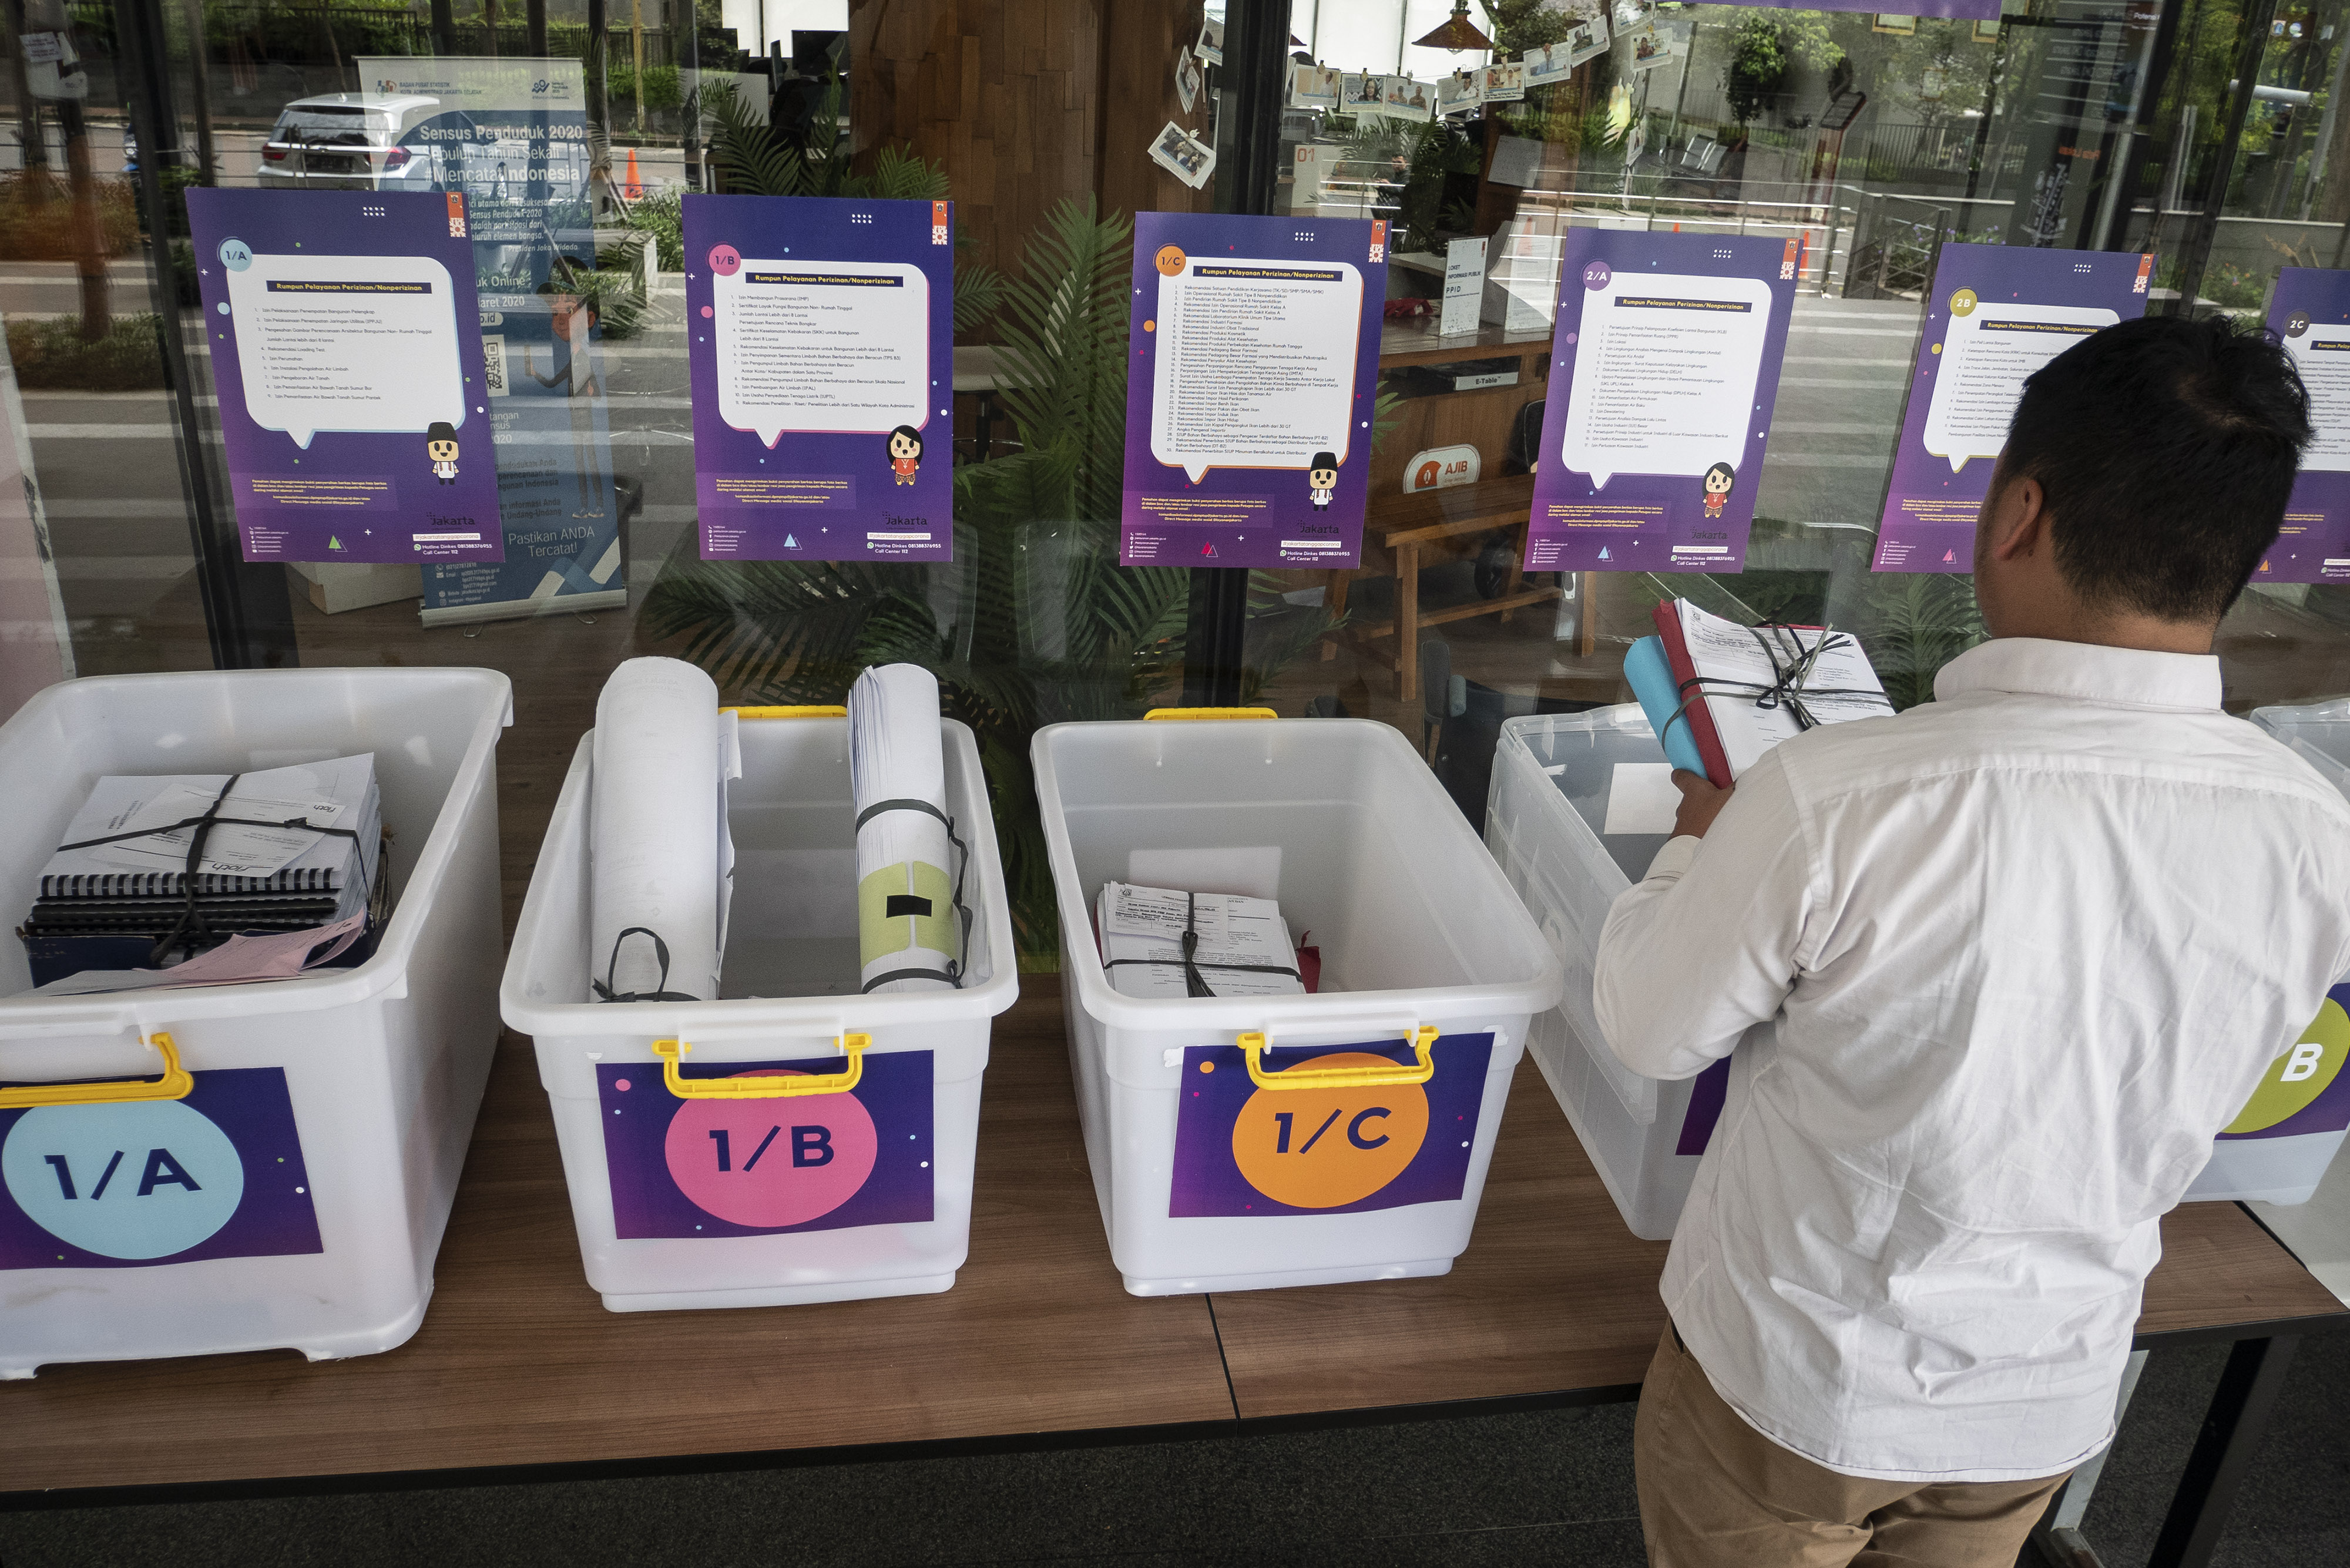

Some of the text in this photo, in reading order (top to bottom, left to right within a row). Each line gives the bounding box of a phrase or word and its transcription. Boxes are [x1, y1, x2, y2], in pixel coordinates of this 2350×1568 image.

[420, 125, 582, 140] Sensus Penduduk 2020
[422, 146, 559, 162] Sepuluh Tahun Sekali
[1297, 147, 1315, 163] 01
[470, 209, 542, 219] Sensus Penduduk 2020
[529, 220, 542, 228] dari
[226, 250, 247, 261] 1/A
[714, 255, 735, 266] 1/B
[1161, 256, 1181, 266] 1/C
[491, 276, 525, 287] Online
[818, 276, 894, 285] Perizinan/Nonperizinan
[1586, 271, 1607, 282] 2/A
[502, 296, 525, 307] 2020
[1677, 301, 1744, 310] Perizinan/Nonperizinan
[1445, 461, 1468, 475] AJIB
[508, 526, 595, 545] Pastikan ANDA
[528, 542, 578, 557] Tercatat!
[1274, 1107, 1392, 1155] 1/C
[709, 1123, 835, 1174] 1/B
[45, 1147, 202, 1201] 1/A
